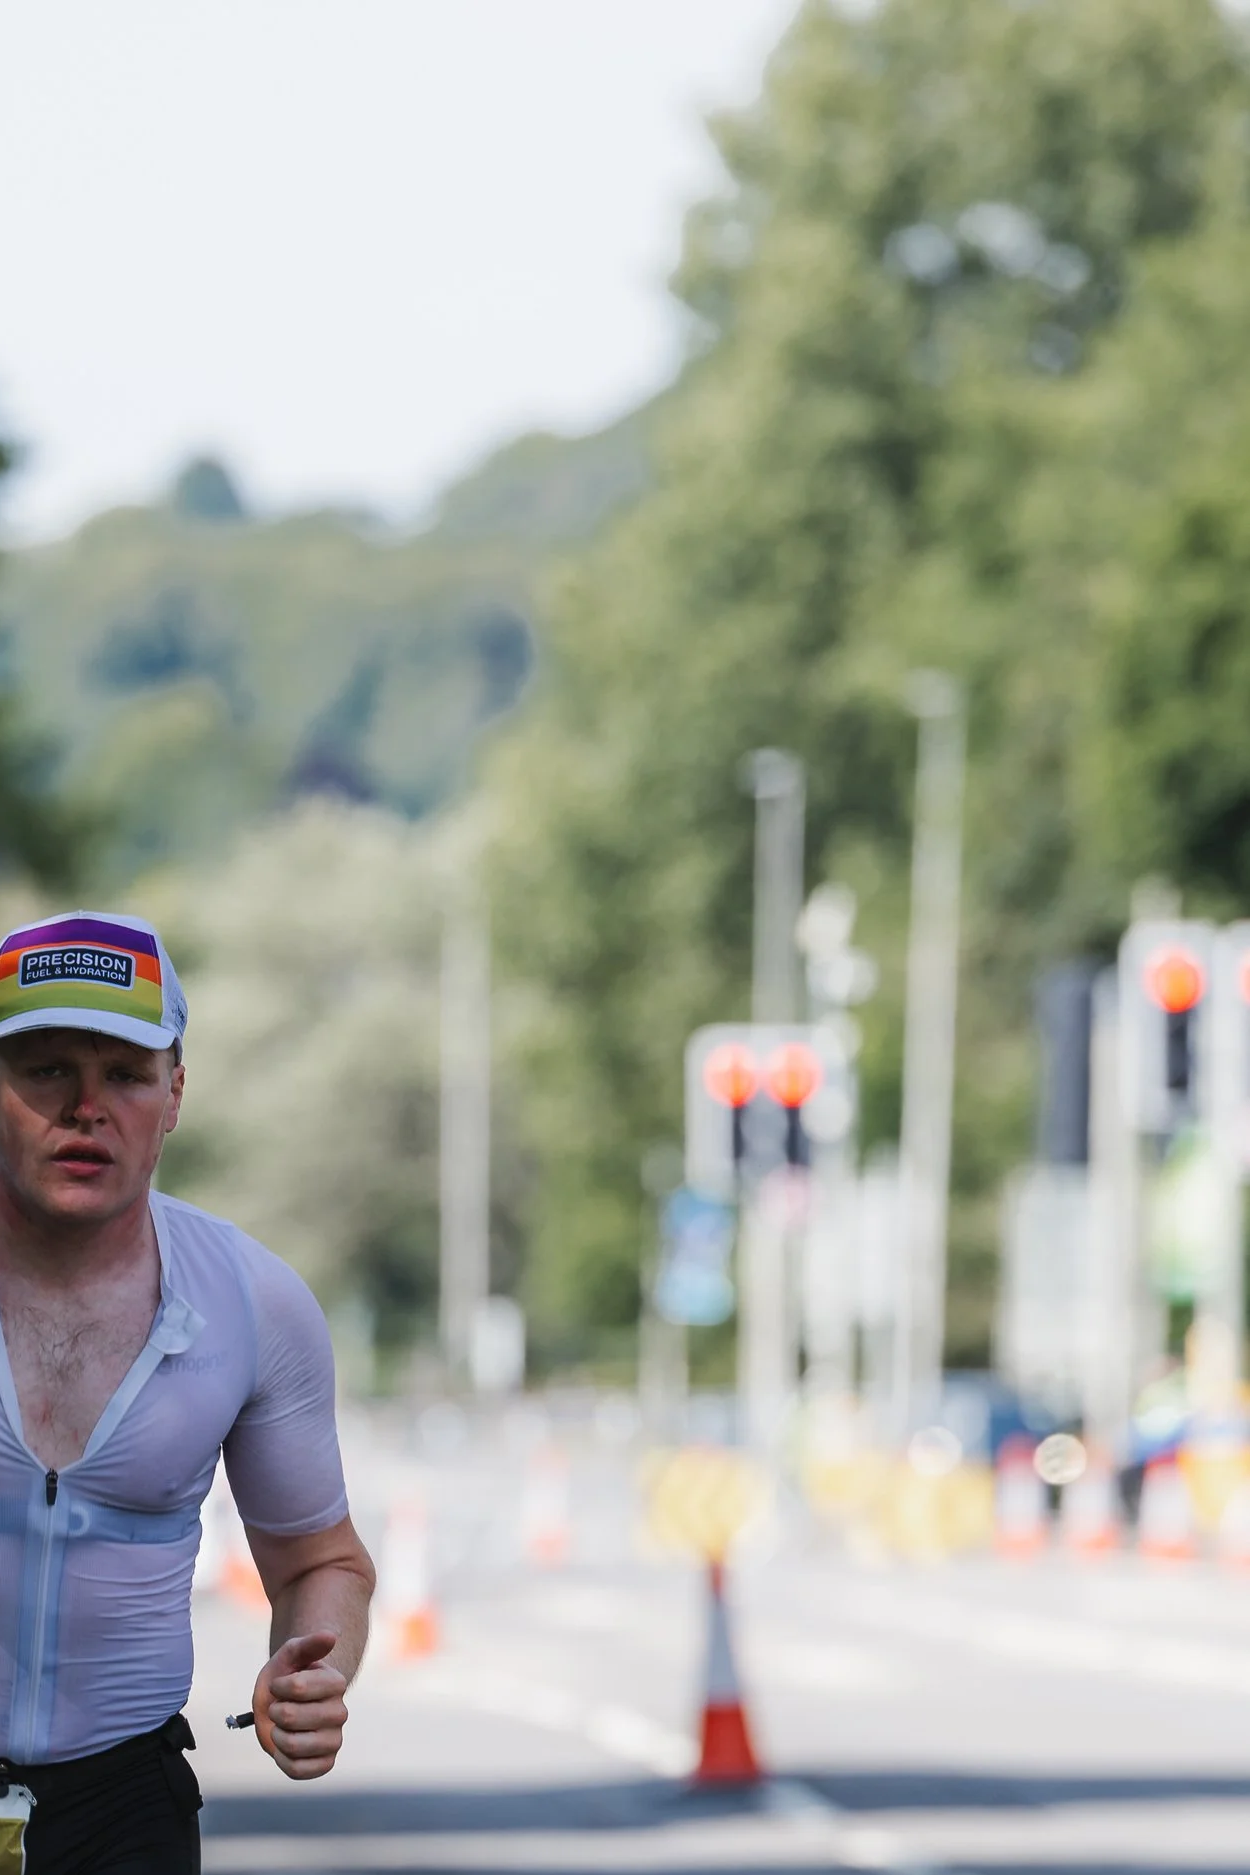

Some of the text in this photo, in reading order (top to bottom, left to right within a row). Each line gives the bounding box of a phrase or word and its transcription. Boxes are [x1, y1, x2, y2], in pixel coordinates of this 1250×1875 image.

[26, 952, 127, 972] PRECISION
[26, 966, 126, 982] FUEL & HYDRATION
